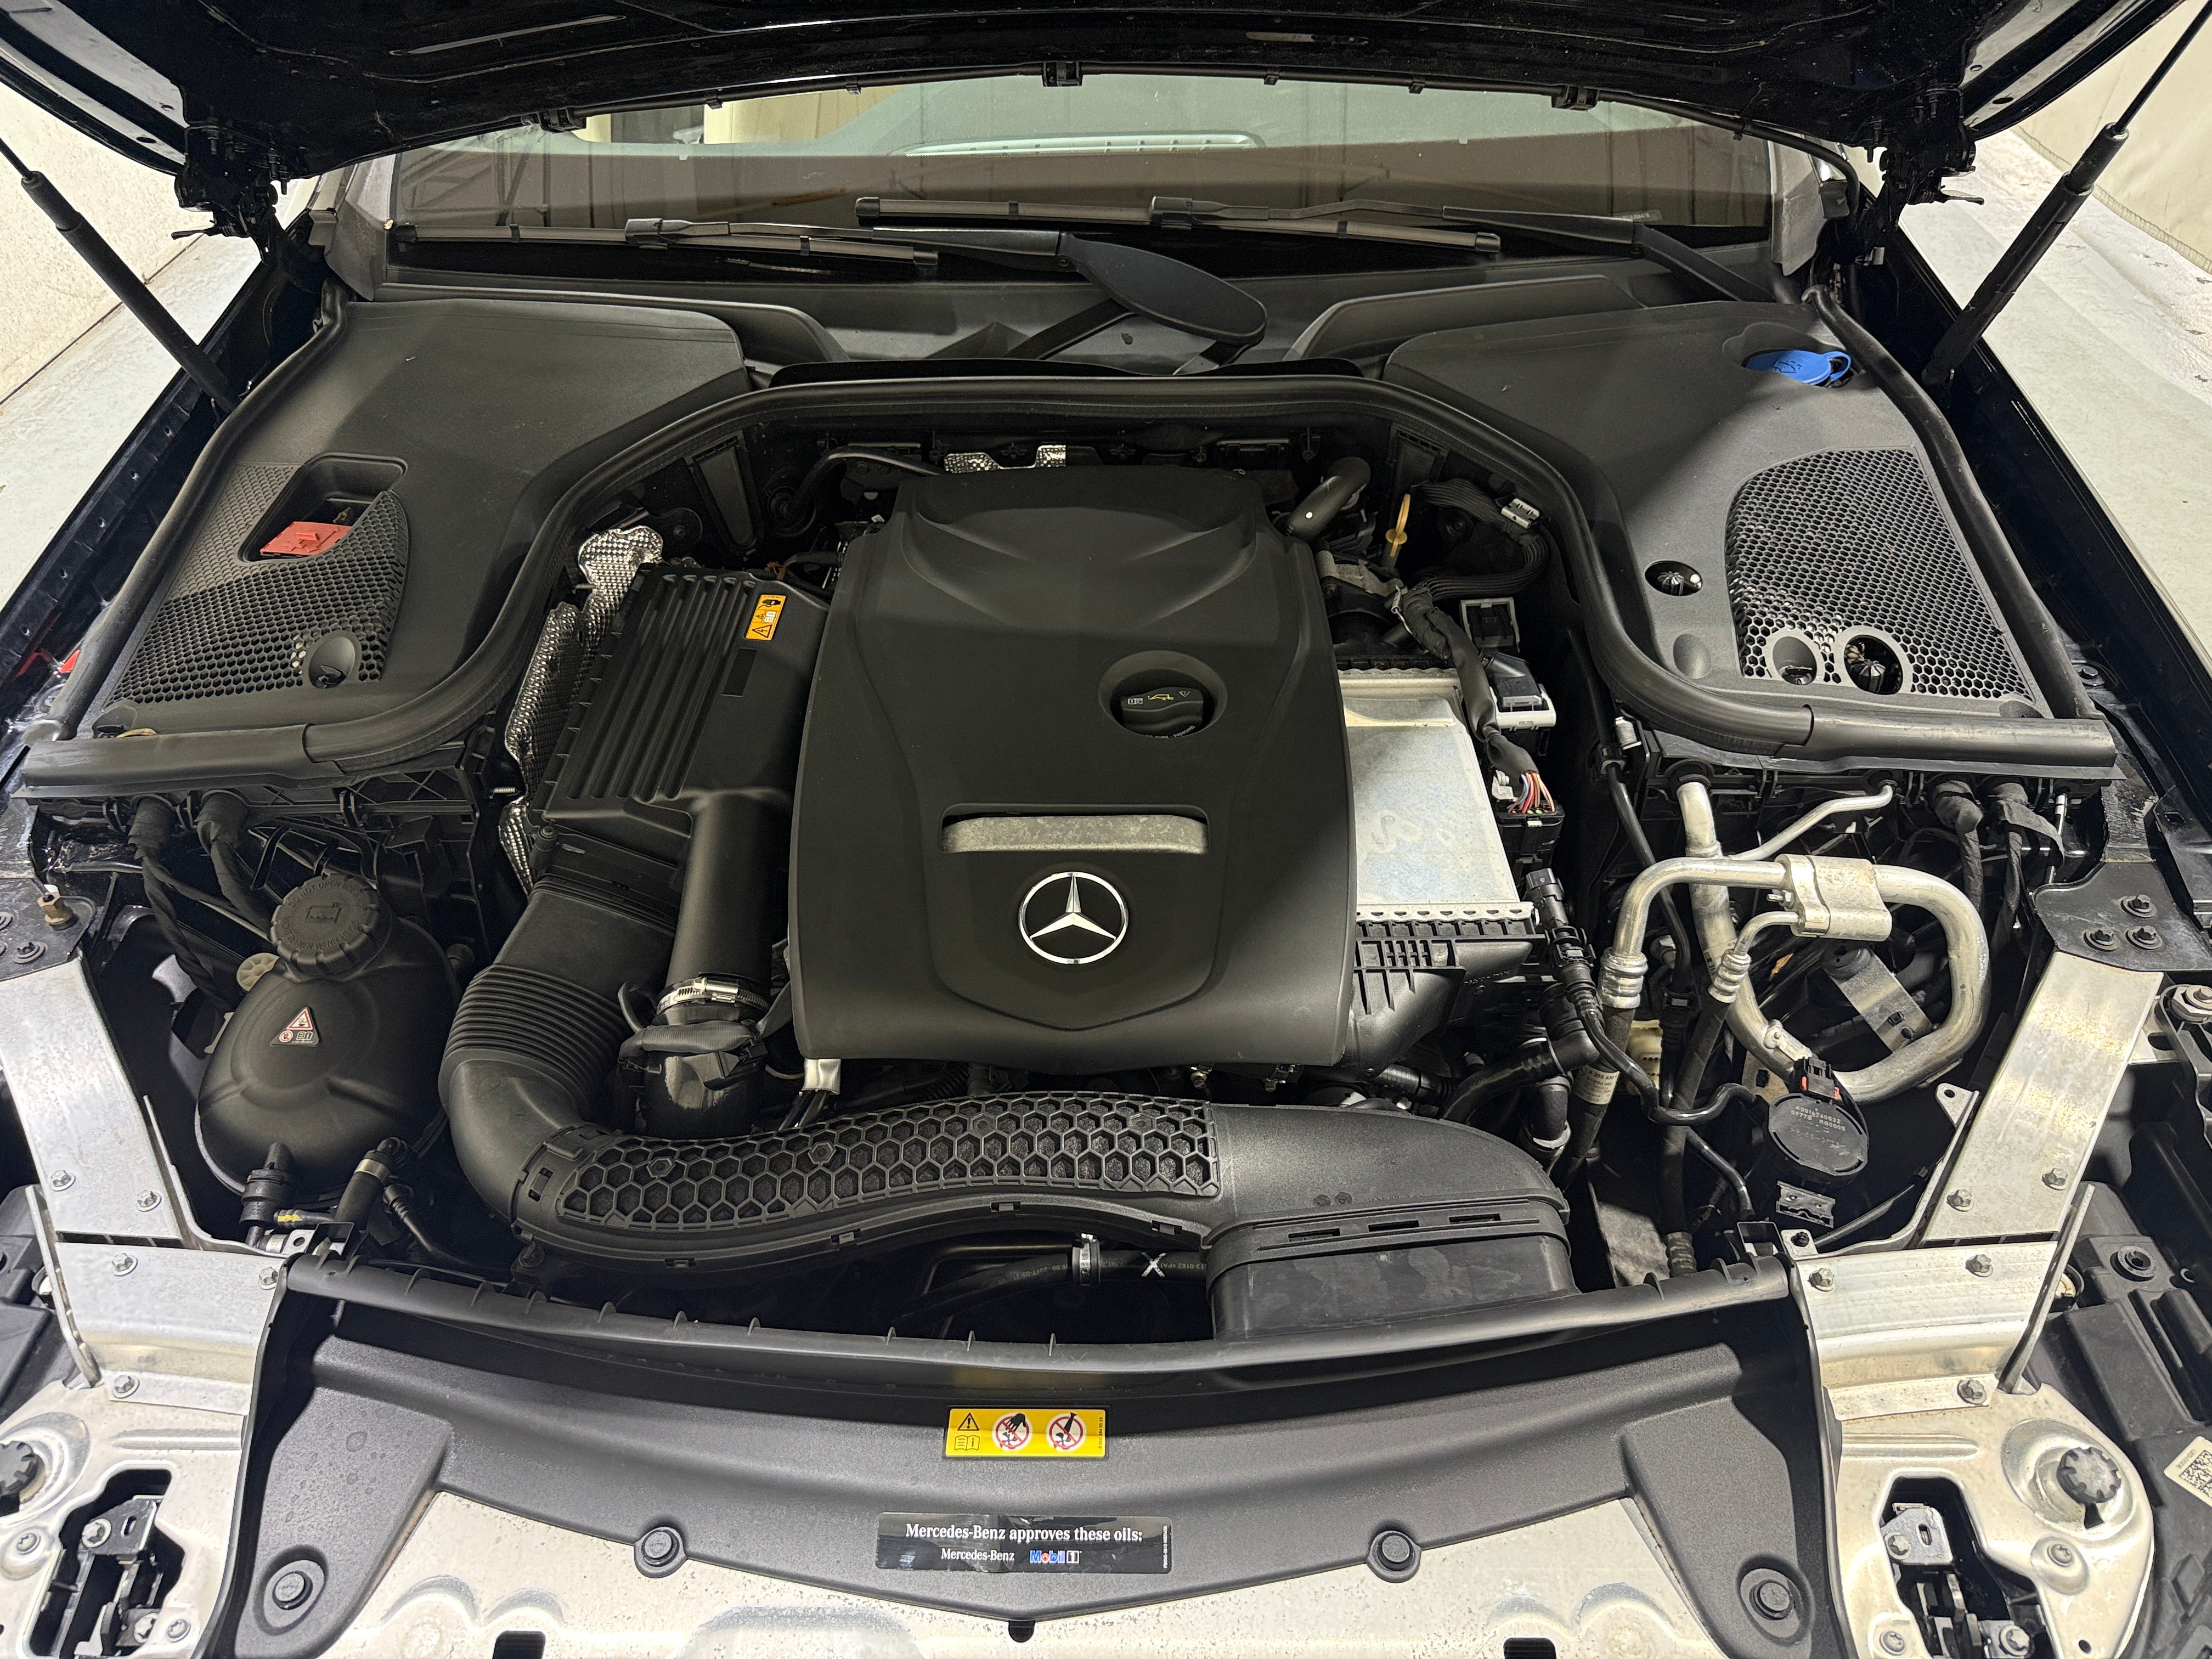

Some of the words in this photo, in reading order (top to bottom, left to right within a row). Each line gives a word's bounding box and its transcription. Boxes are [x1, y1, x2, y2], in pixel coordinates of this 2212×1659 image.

[905, 1523, 1006, 1541] Mercedes-Benz
[1009, 1528, 1070, 1543] approves
[1074, 1527, 1110, 1541] these
[1114, 1527, 1143, 1542] oils:
[941, 1548, 1015, 1562] Mercedes-Benz
[1029, 1550, 1065, 1564] Mobil
